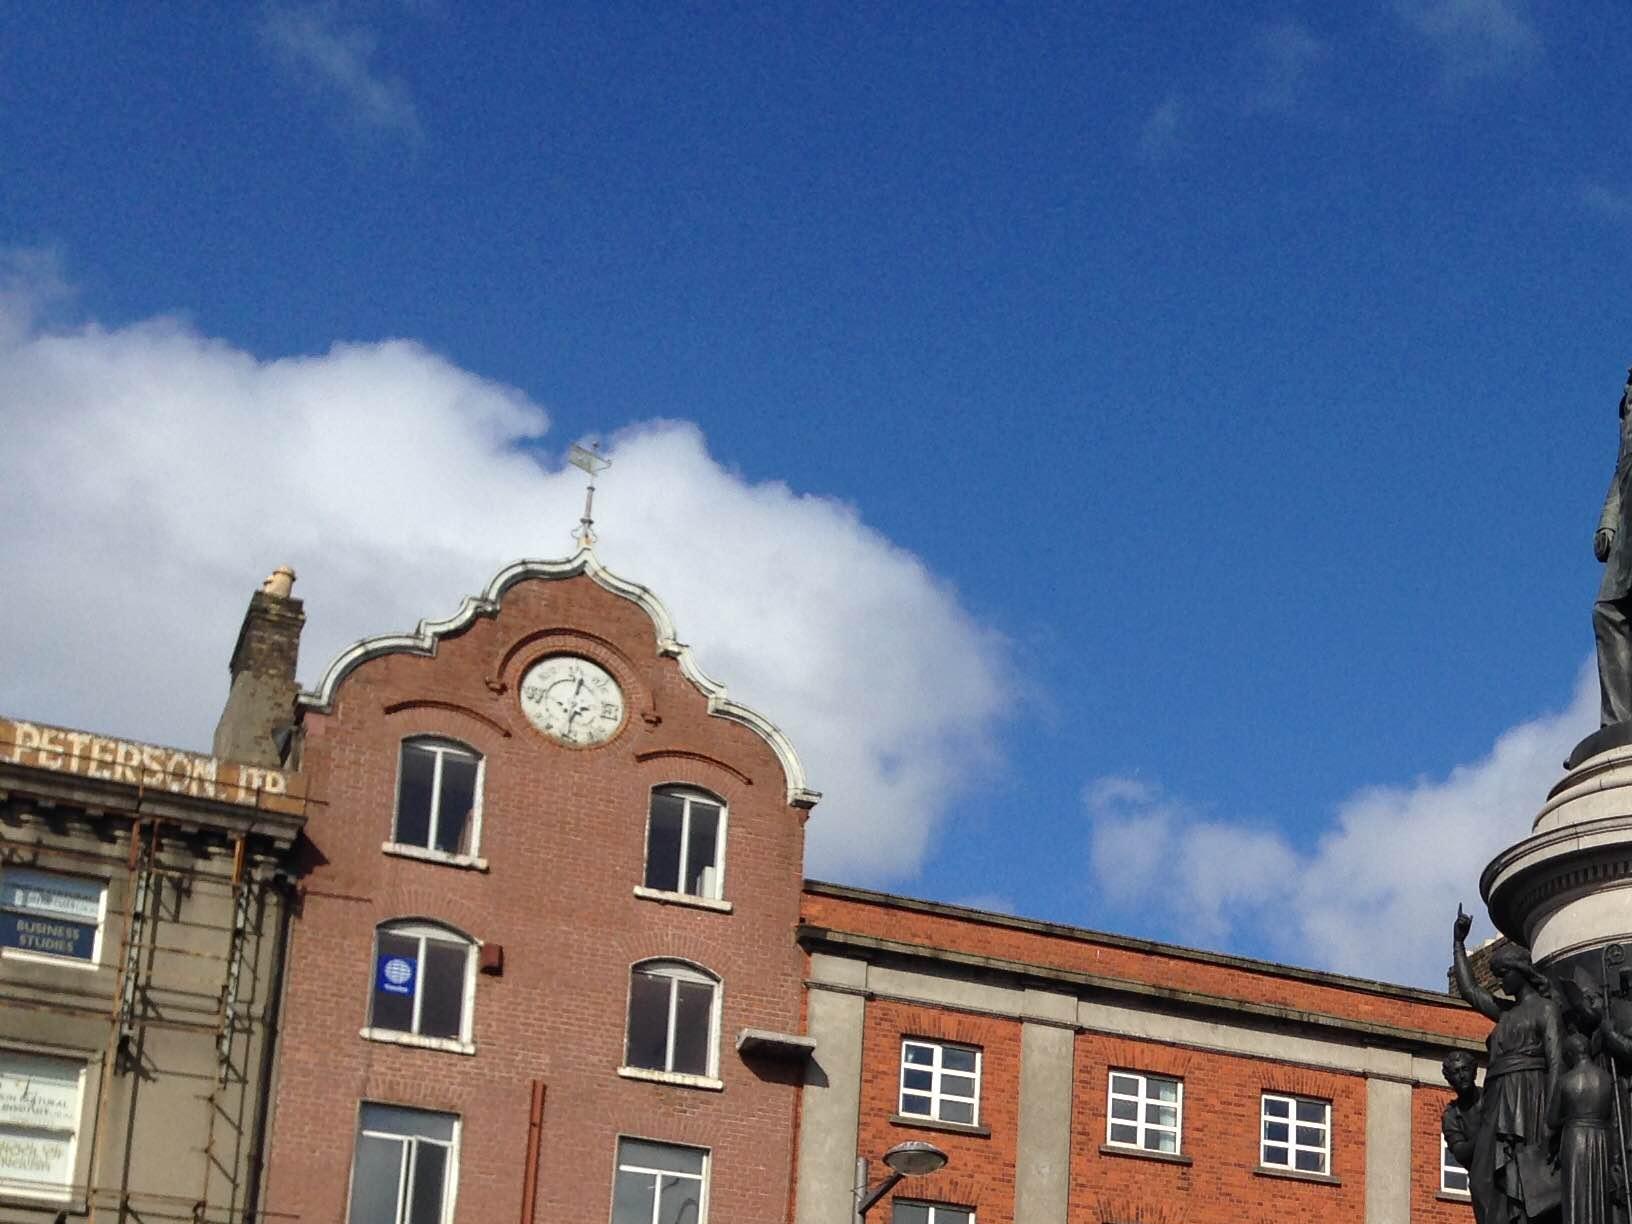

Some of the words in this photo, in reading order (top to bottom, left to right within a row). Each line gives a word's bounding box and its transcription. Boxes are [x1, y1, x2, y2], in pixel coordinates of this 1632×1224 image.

[13, 722, 217, 798] PETERSON
[16, 920, 80, 940] BUSINESS
[19, 934, 74, 952] STUDIES
